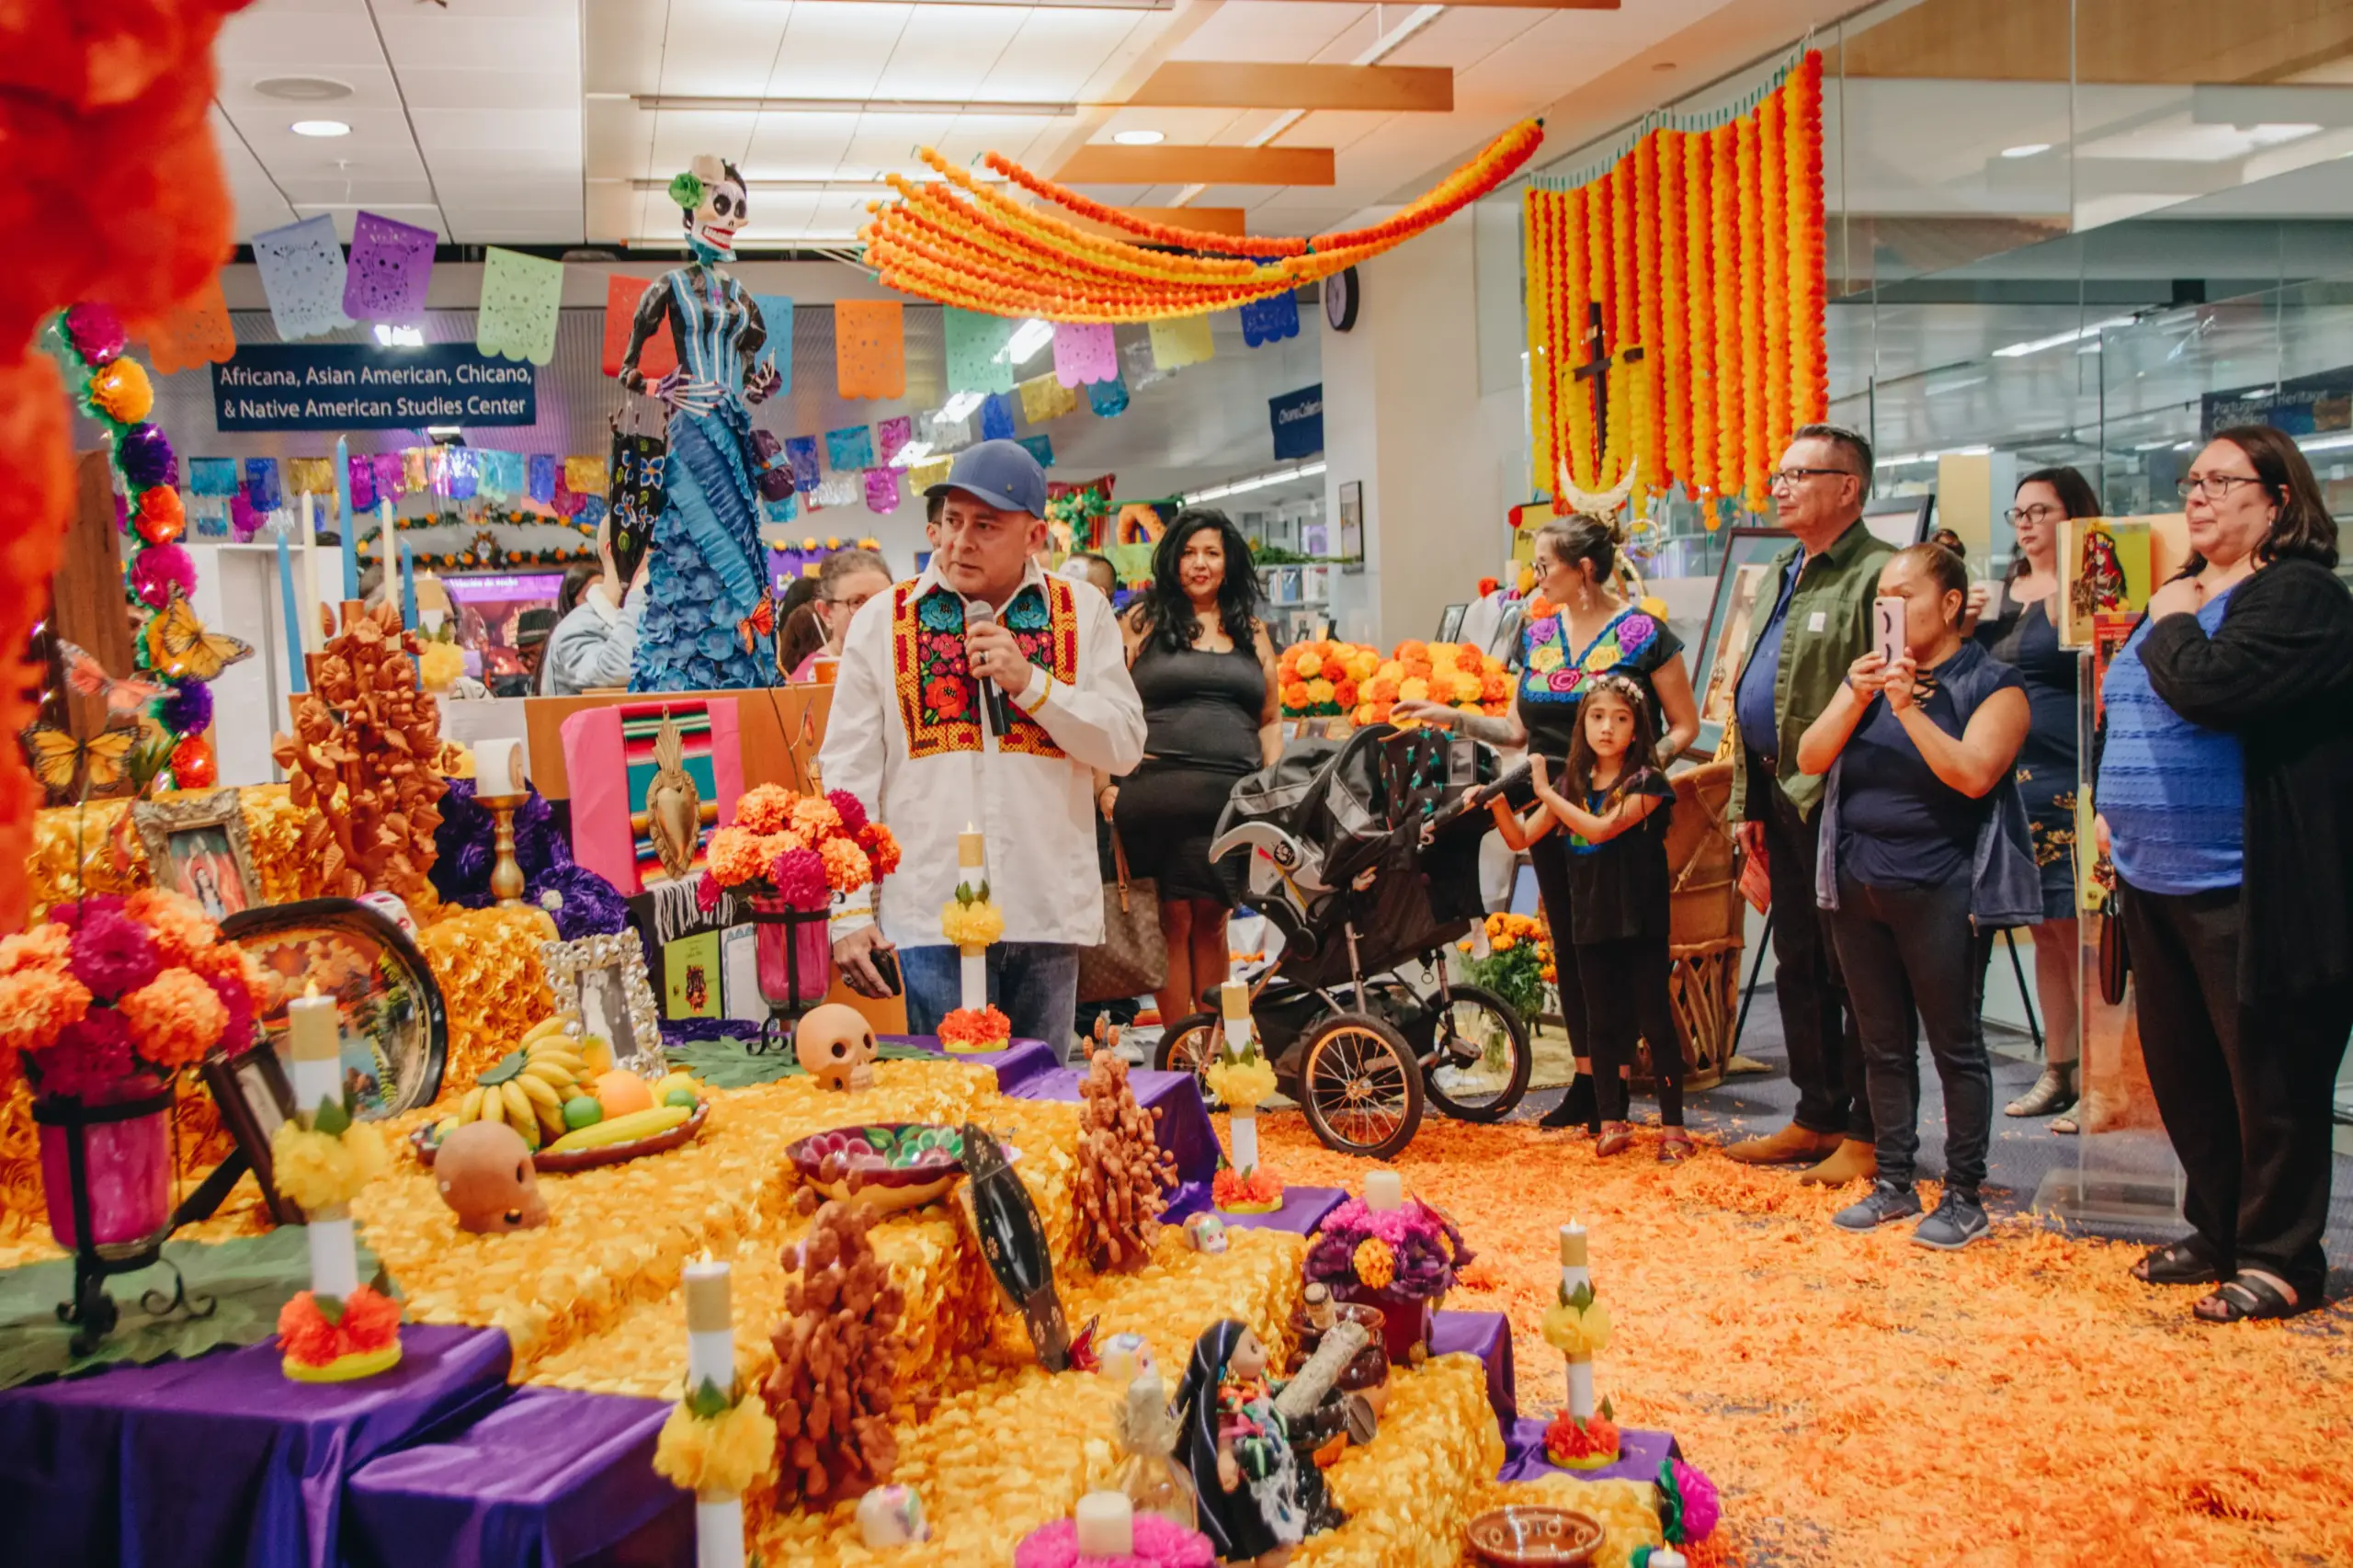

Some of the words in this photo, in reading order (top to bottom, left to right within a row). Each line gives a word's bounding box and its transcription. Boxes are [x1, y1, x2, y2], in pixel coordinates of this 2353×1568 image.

[220, 366, 301, 388] Africana,
[306, 366, 356, 385] Asian
[361, 365, 452, 386] American,
[456, 363, 532, 385] Chicano,
[224, 399, 235, 418] &
[239, 399, 300, 418] Native
[305, 398, 392, 417] American
[397, 396, 463, 416] Studies
[467, 395, 526, 415] Center
